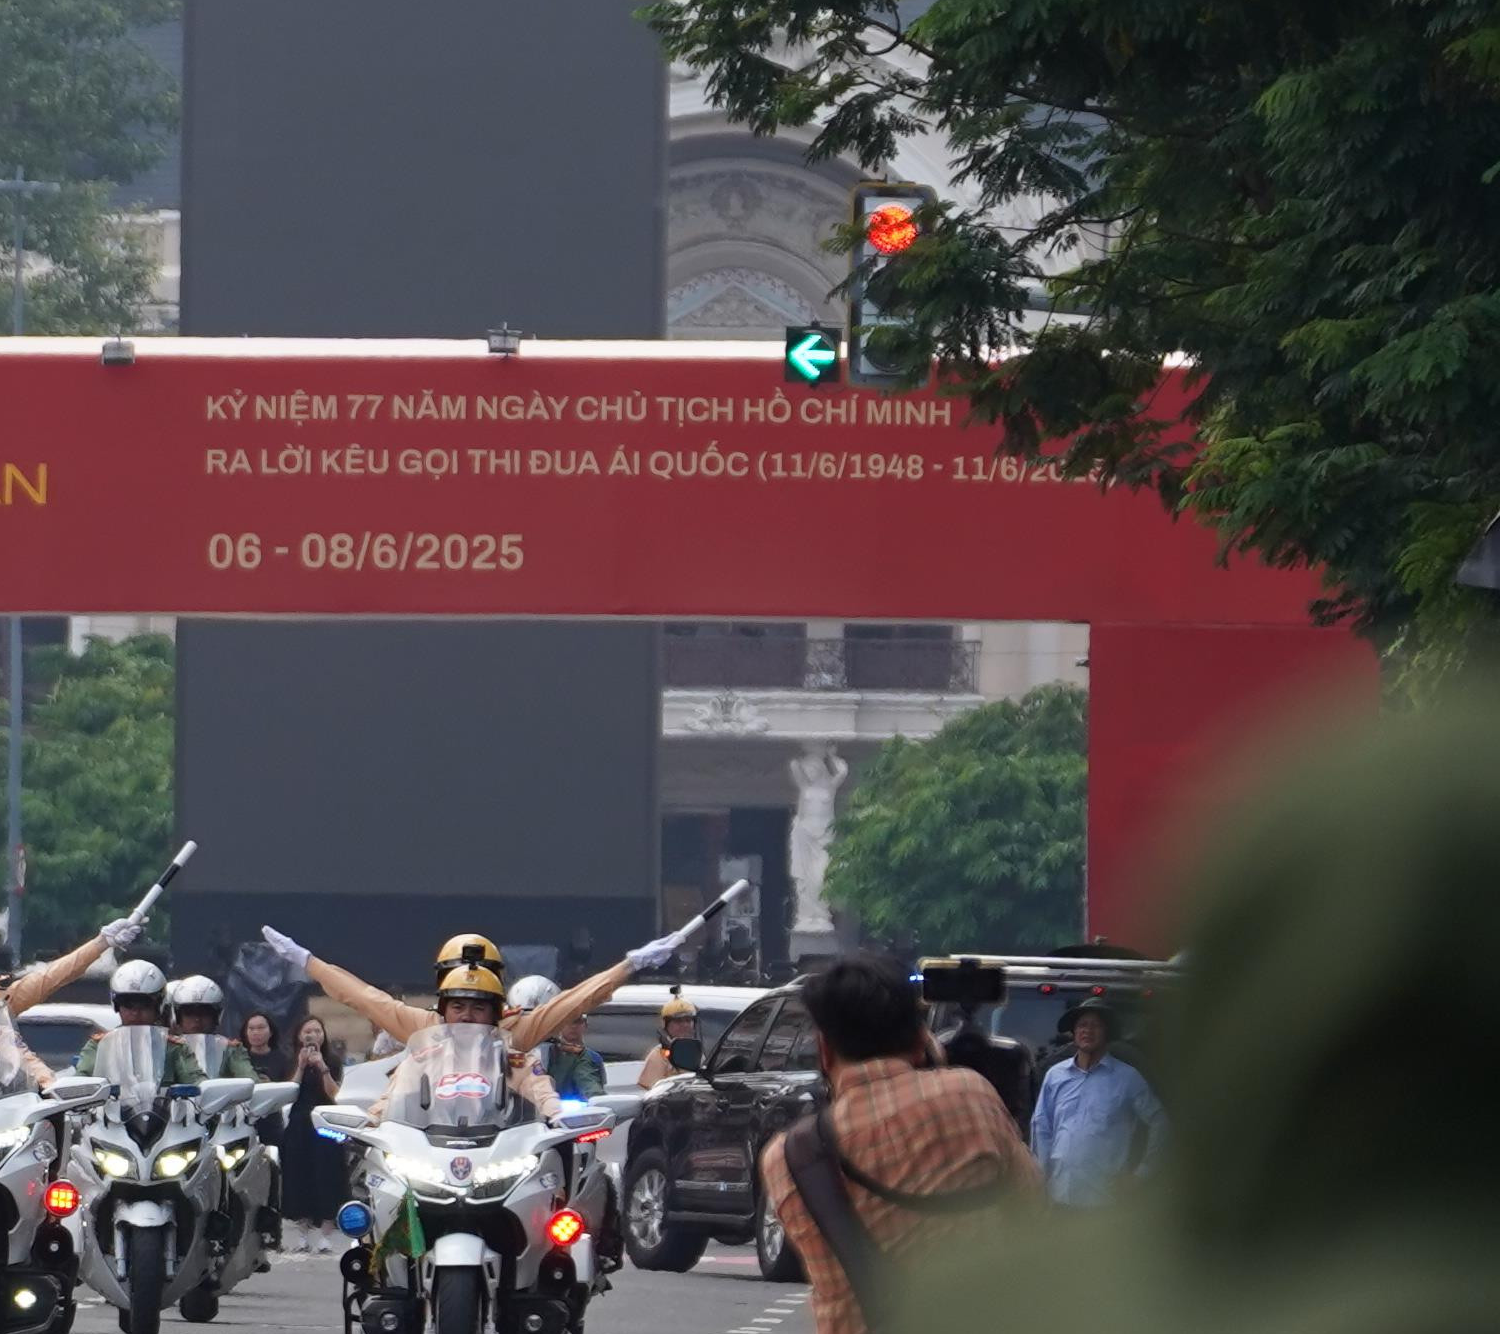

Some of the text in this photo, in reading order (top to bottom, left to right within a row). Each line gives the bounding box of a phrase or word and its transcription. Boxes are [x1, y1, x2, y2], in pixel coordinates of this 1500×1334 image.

[206, 387, 952, 428] KỶ NIỆM 77 NĂM NGÀY CHỦ TỊCH HỒ CHÍ MINH
[206, 449, 252, 475] RA
[261, 443, 312, 475] LỜI
[321, 443, 390, 475] KÊU
[398, 449, 459, 480] GỌI
[467, 449, 521, 475] THI
[528, 449, 601, 476] ĐUA
[607, 444, 641, 476] ÁI
[650, 440, 749, 480] QUỐC
[757, 451, 925, 482] (11/6/1948
[208, 533, 263, 570] 06
[301, 530, 525, 572] 08/6/2025
